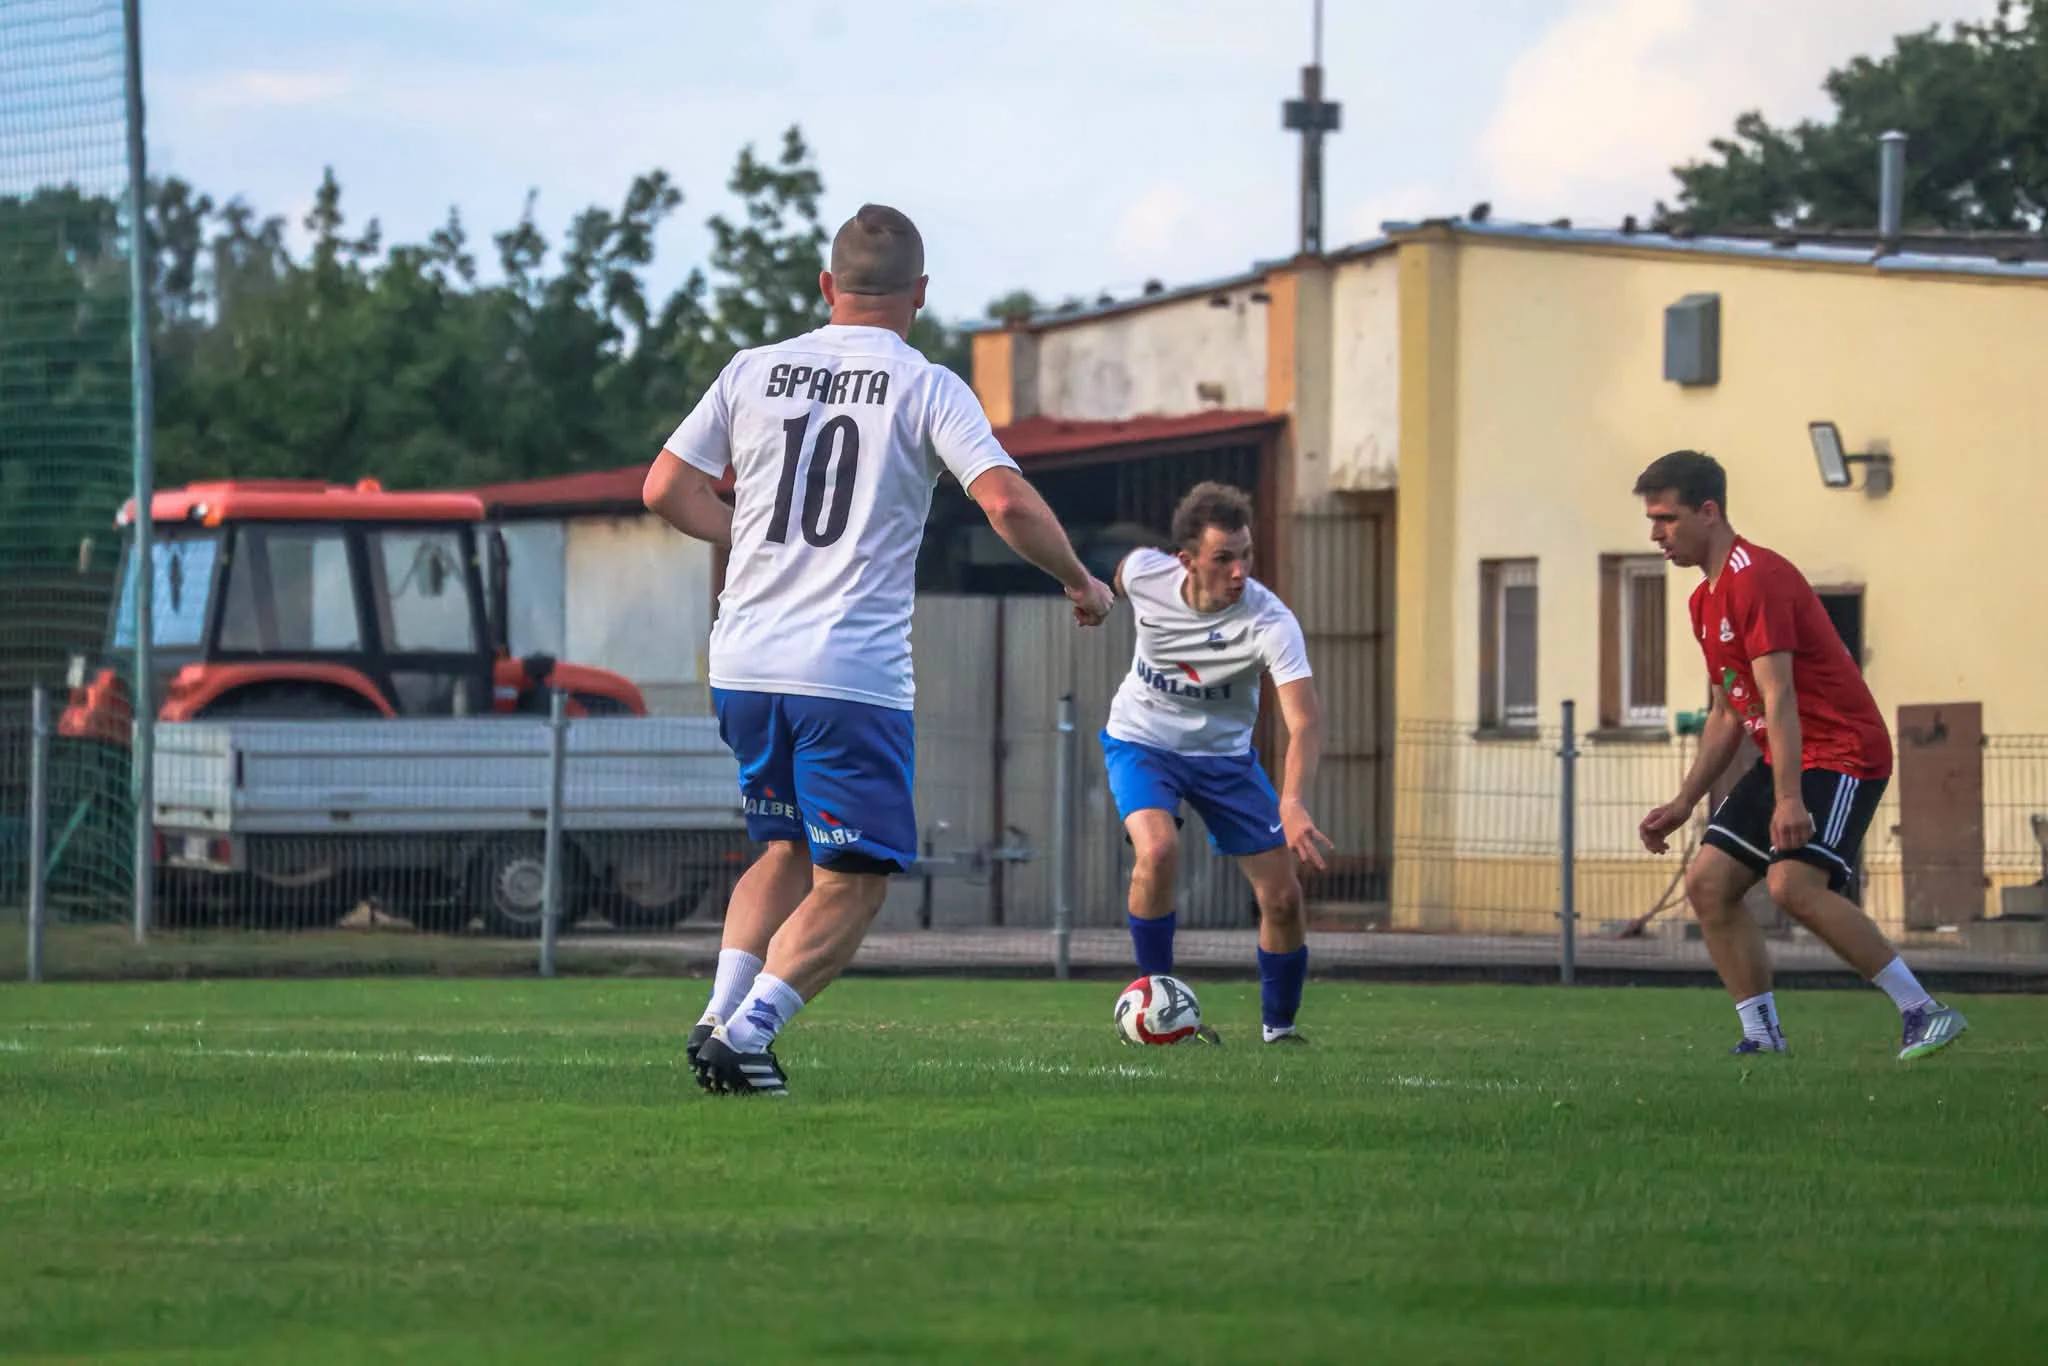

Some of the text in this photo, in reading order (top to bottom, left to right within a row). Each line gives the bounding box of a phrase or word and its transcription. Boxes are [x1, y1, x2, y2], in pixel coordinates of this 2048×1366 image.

[765, 363, 890, 405] SPARTA
[765, 411, 860, 548] 10
[742, 796, 800, 820] ALBE
